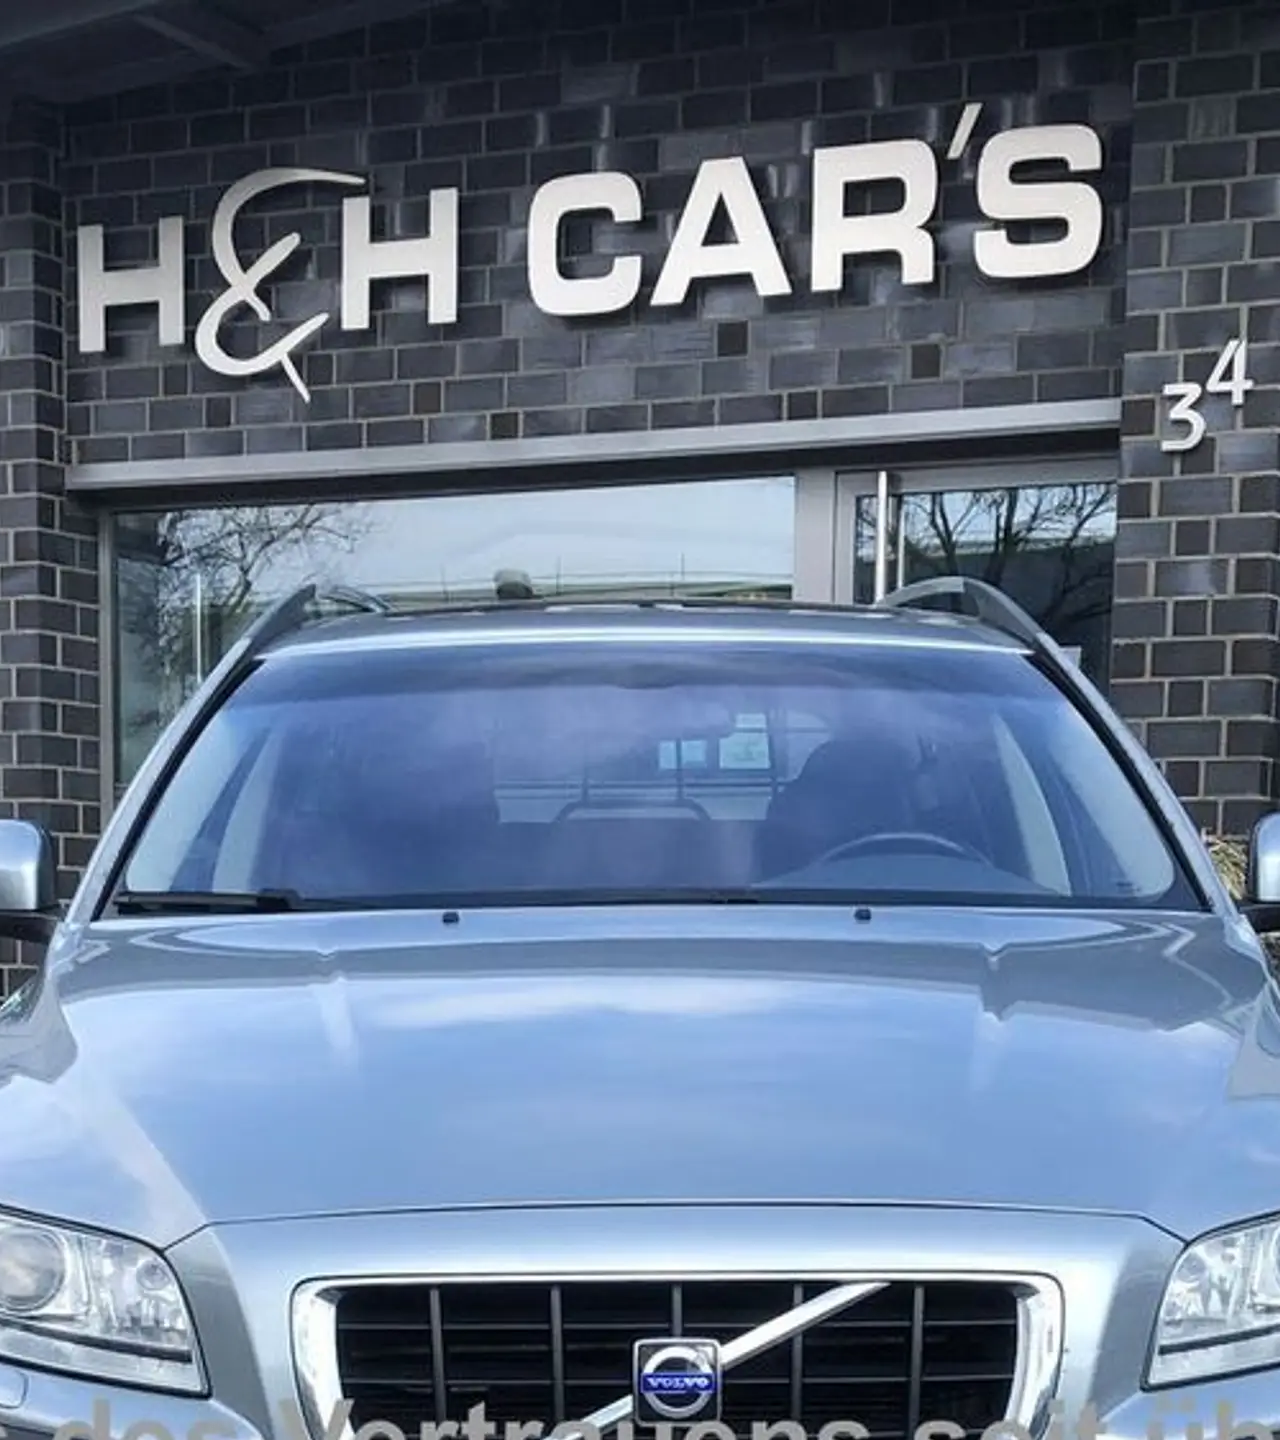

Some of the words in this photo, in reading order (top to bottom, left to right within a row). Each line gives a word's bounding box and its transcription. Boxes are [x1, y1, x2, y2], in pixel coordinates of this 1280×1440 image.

[77, 167, 460, 402] H&H
[526, 102, 1104, 318] CAR'S
[646, 1376, 710, 1388] VOLVO
